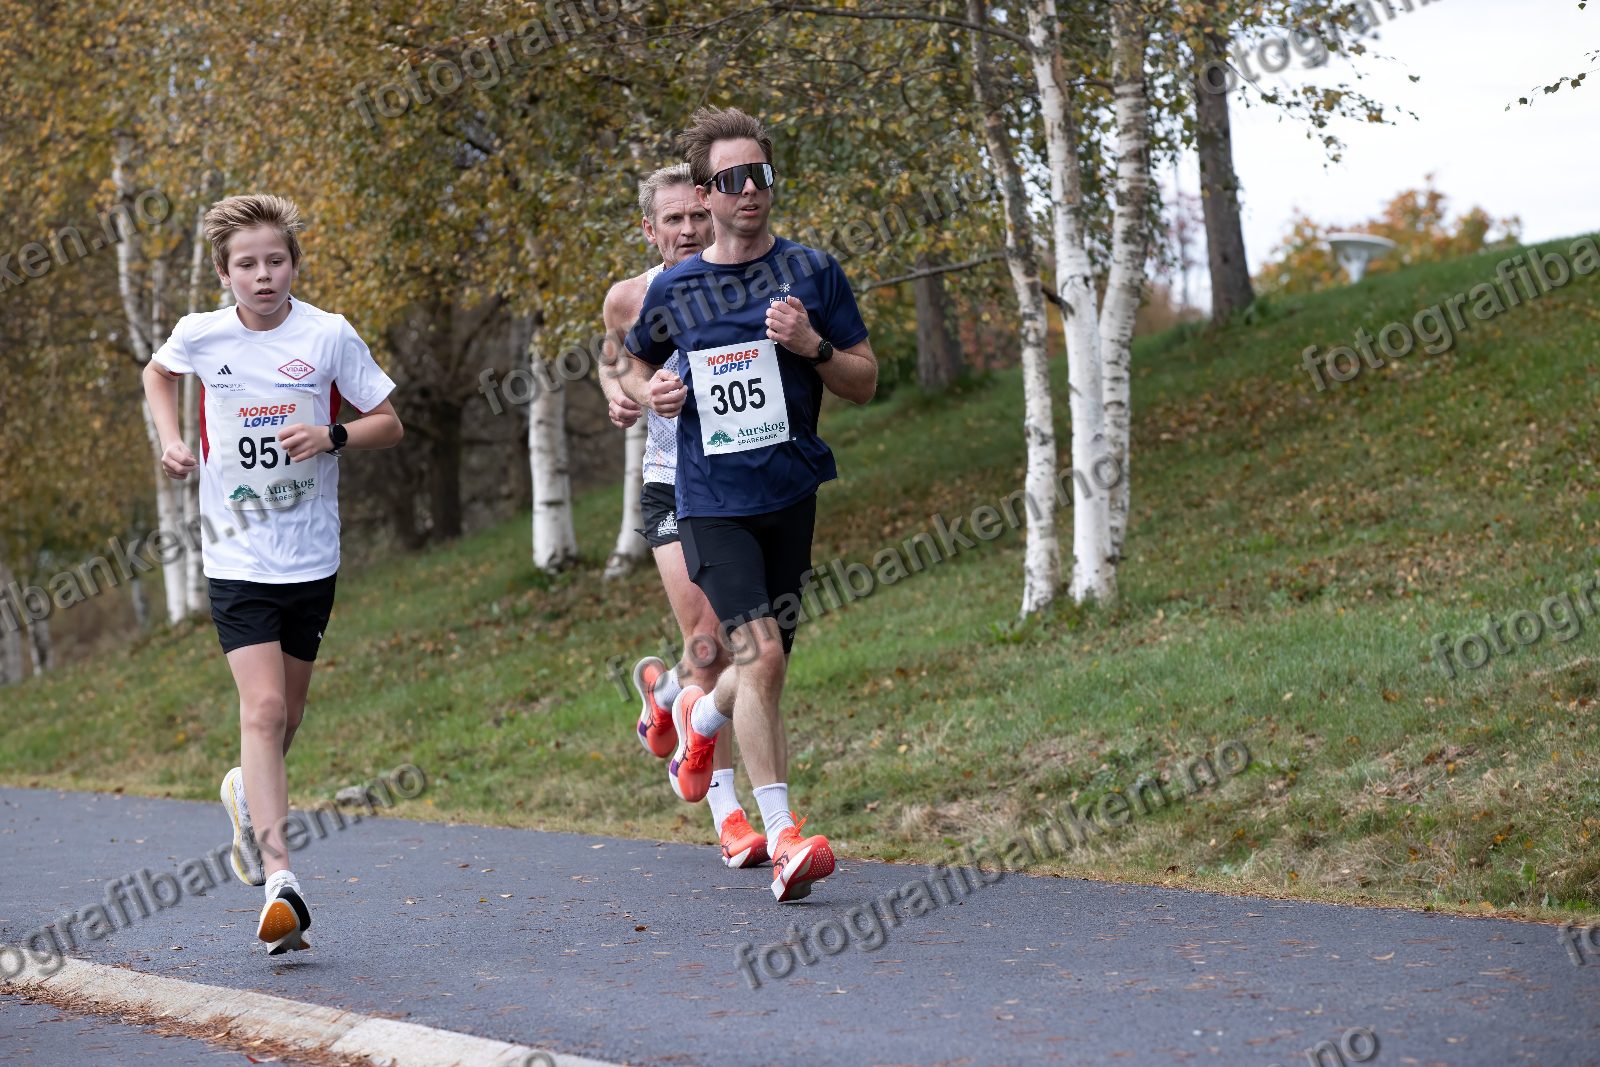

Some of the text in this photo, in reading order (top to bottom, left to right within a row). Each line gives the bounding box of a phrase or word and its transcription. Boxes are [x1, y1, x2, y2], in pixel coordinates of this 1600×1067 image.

[707, 349, 759, 366] NORGES
[713, 360, 753, 376] LØPET
[710, 378, 766, 416] 305
[237, 404, 297, 418] NORGES
[244, 415, 288, 428] LØPET
[737, 421, 786, 438] Aurskog
[264, 477, 315, 496] Aurskog
